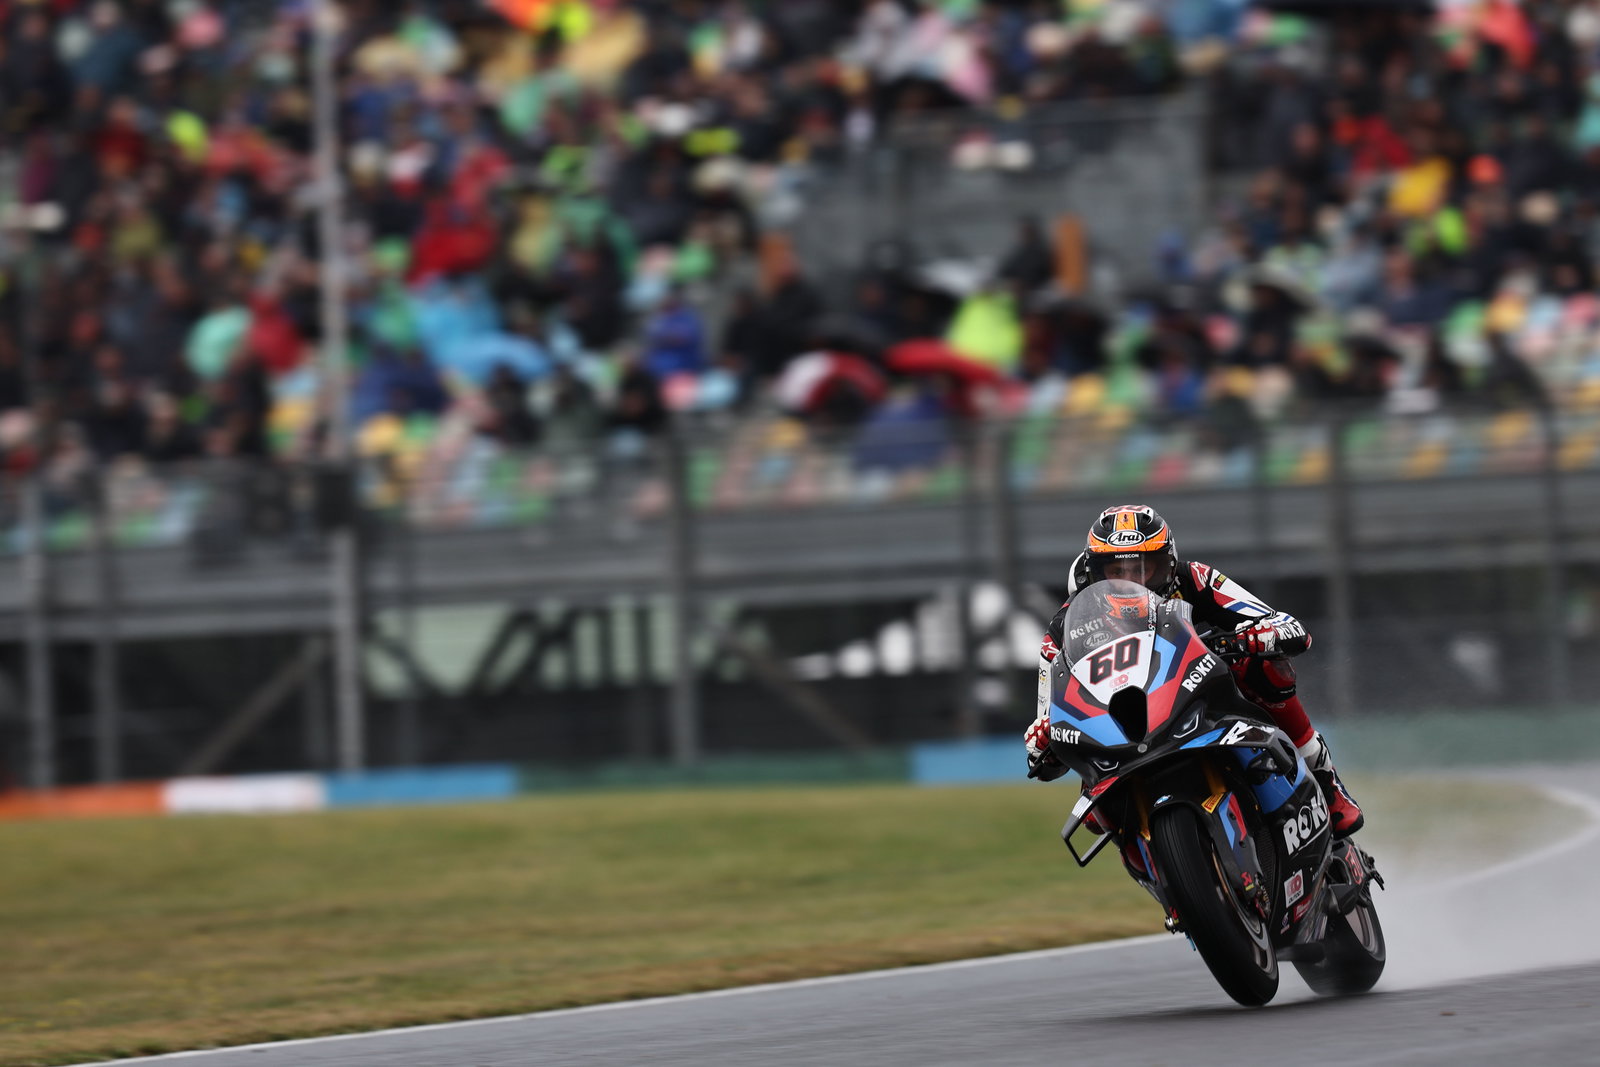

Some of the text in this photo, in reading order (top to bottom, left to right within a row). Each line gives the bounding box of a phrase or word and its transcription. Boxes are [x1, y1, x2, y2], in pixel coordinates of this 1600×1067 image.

[1110, 532, 1141, 543] Arai
[1086, 636, 1141, 685] 60
[1181, 653, 1217, 693] ROKiT
[1050, 726, 1081, 744] ROKiT
